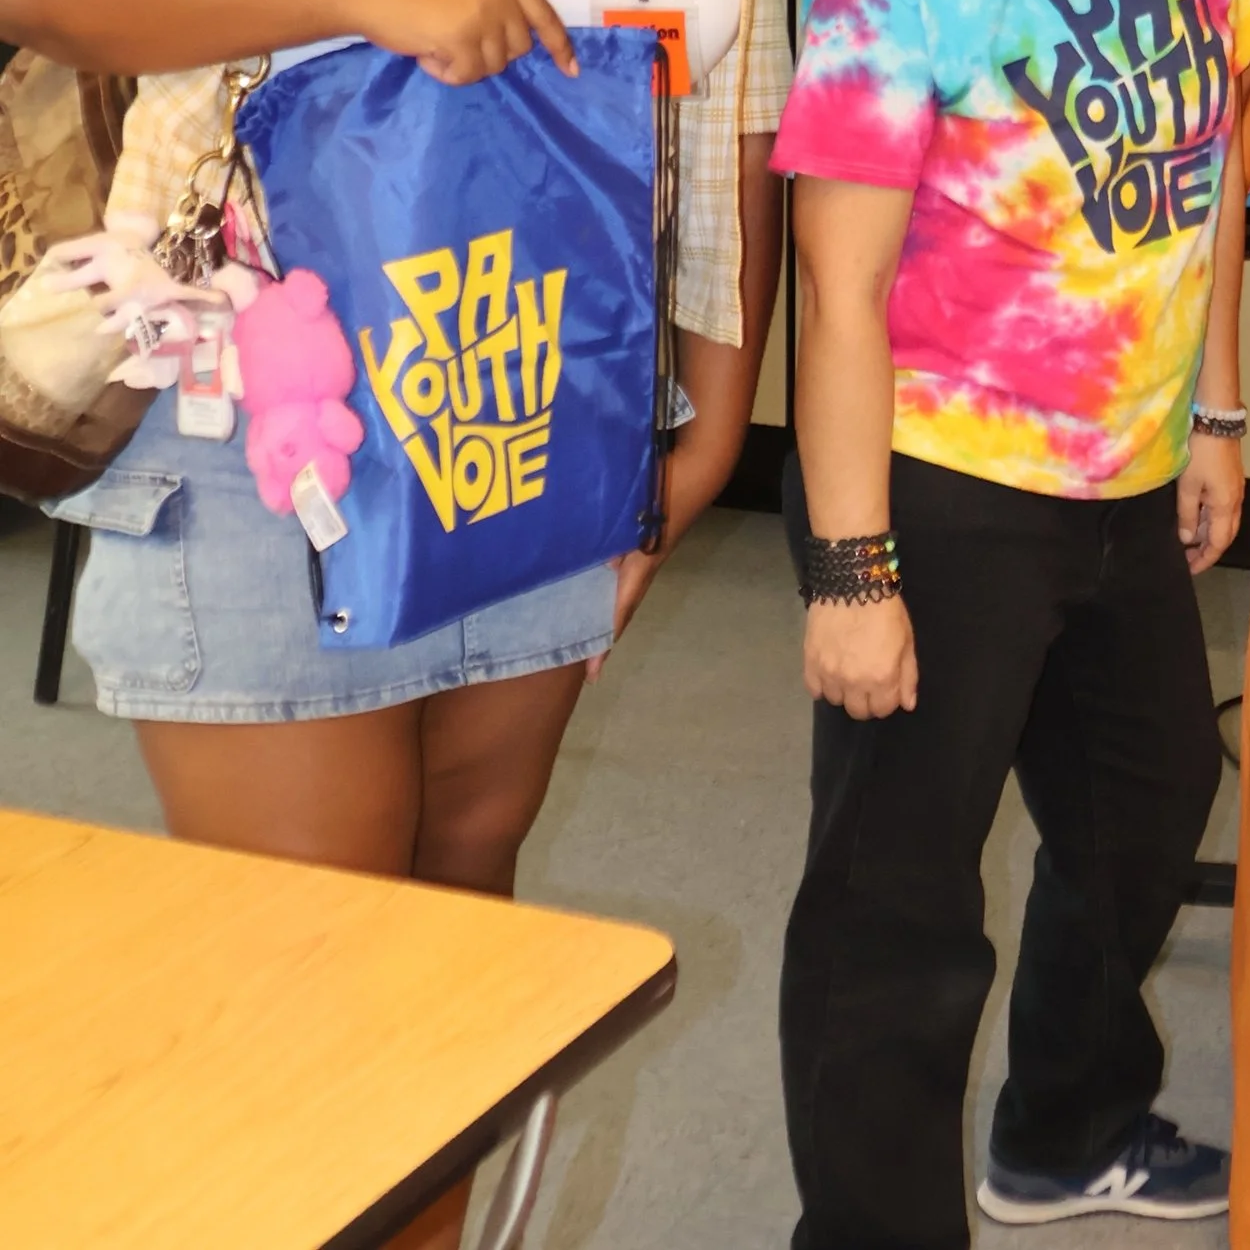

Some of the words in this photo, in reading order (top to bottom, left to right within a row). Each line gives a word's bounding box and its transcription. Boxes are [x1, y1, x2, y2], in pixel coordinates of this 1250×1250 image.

[1075, 135, 1217, 255] VOTE
[357, 268, 568, 443] YOUTH
[382, 228, 514, 362] PA
[403, 407, 552, 534] VOTE
